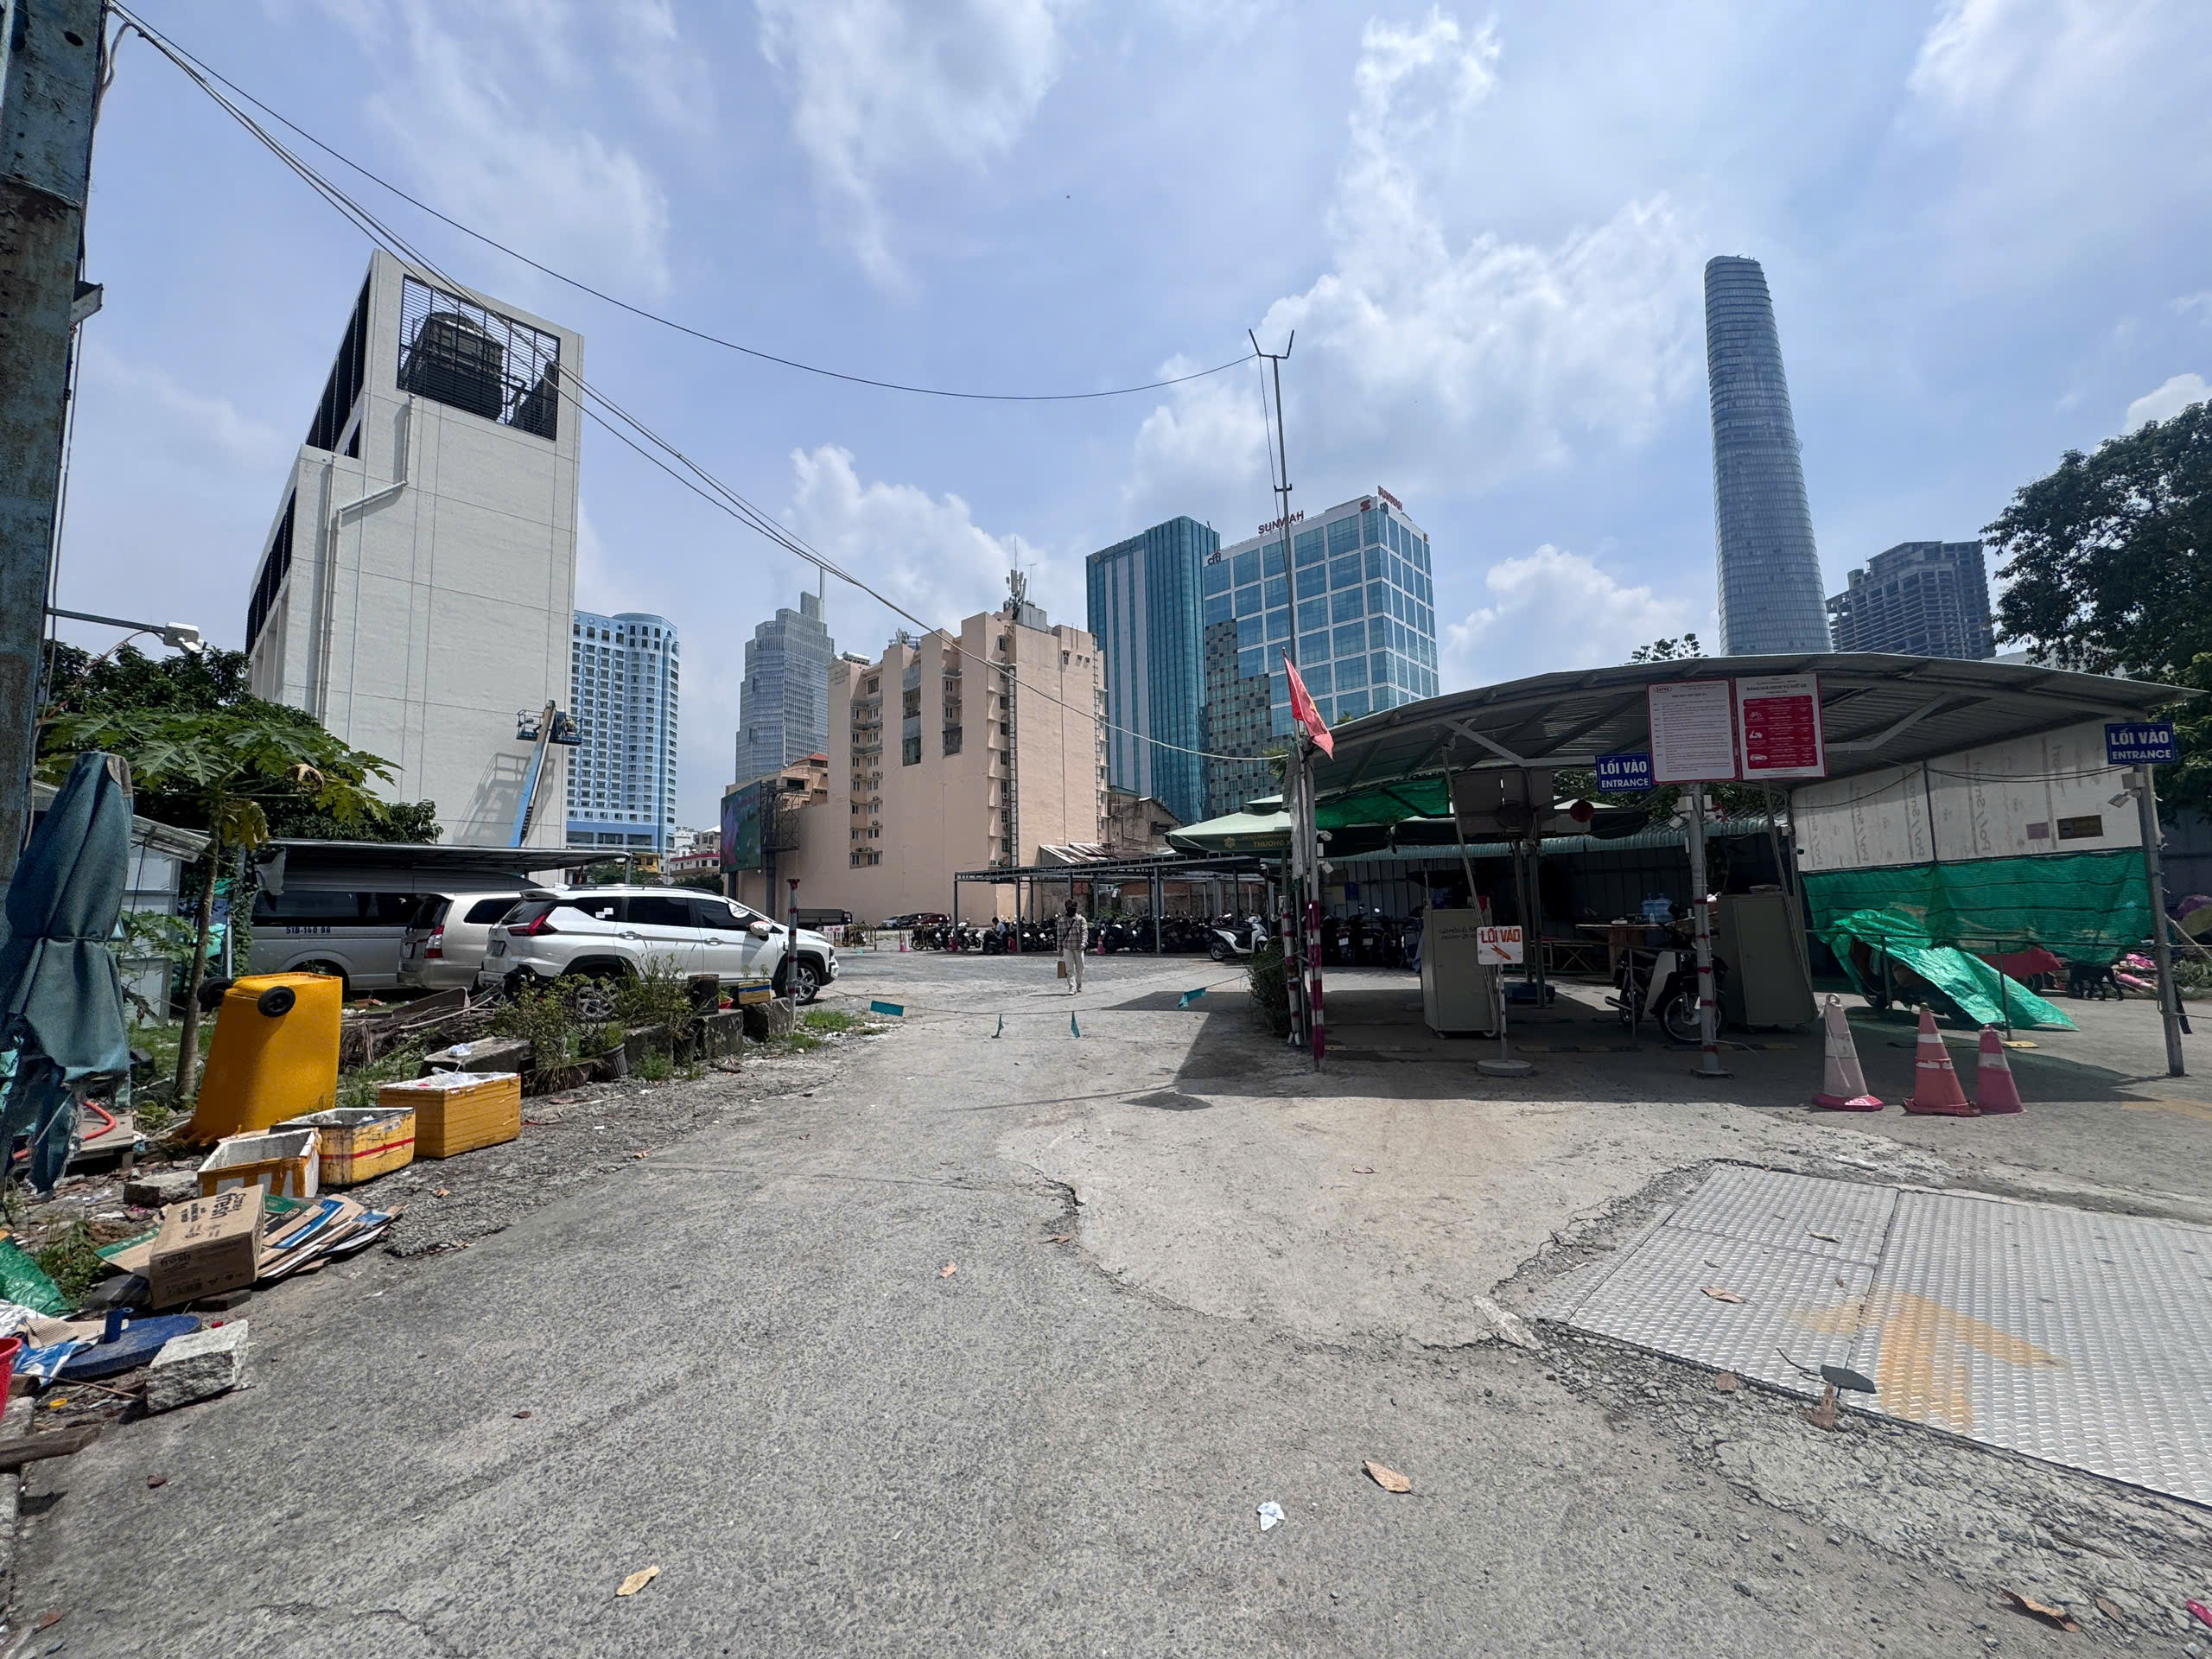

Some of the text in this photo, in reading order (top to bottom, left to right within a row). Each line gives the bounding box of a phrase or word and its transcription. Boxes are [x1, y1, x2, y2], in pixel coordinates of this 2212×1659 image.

[1207, 549, 1222, 565] citi
[2110, 728, 2169, 746] LỐI VÀO
[2112, 749, 2172, 760] ENTRANCE
[1600, 758, 1648, 775] LỐI VÀO
[1601, 778, 1649, 788] ENTRANCE
[1481, 926, 1498, 944] LỐI
[1500, 927, 1521, 943] VÀO
